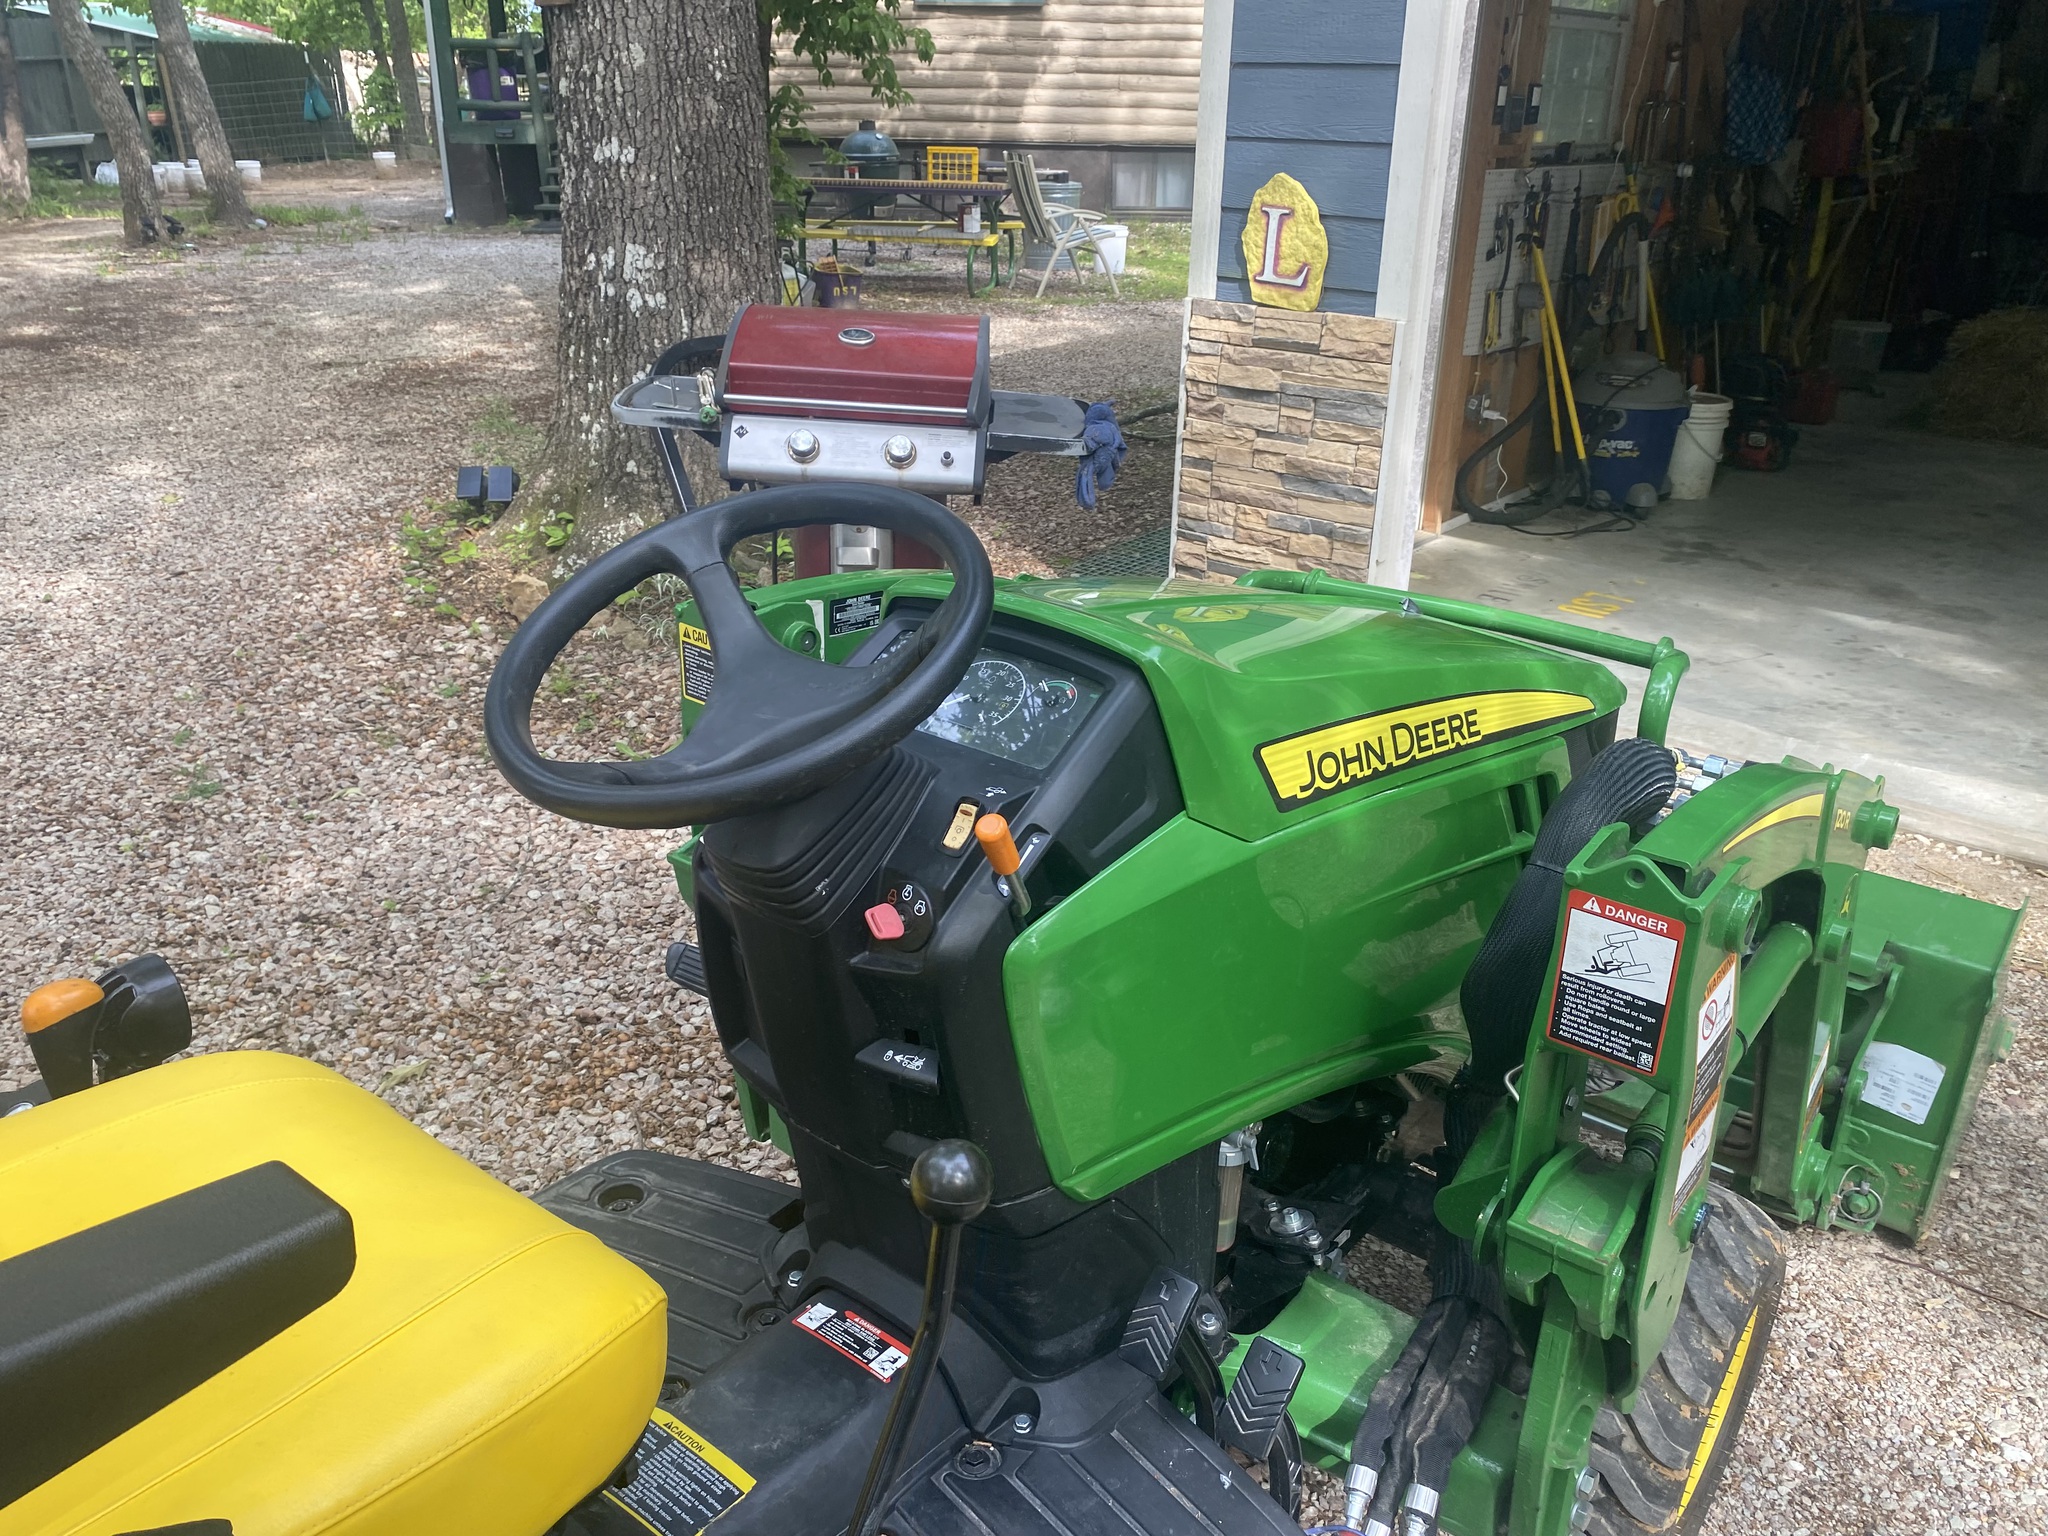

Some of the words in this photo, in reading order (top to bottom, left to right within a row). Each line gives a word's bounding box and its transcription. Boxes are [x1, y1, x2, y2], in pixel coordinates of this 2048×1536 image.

[1255, 206, 1310, 288] L
[1299, 735, 1387, 793] JOHN
[1389, 708, 1482, 763] DEERE
[1604, 904, 1669, 934] DANGER
[1560, 979, 1579, 989] result
[1579, 985, 1595, 995] from
[1595, 991, 1626, 1006] rollovers.
[1562, 973, 1586, 985] Serious
[1586, 982, 1605, 993] injury
[1614, 991, 1633, 1001] death
[1633, 998, 1646, 1006] can
[1564, 994, 1586, 1006] square
[1587, 1001, 1607, 1012] bales.
[1563, 999, 1576, 1008] Use
[1595, 1010, 1607, 1019] and
[1608, 1015, 1633, 1029] seatbelt
[1571, 1008, 1591, 1020] times.
[1576, 991, 1587, 999] not
[1588, 995, 1609, 1007] handle
[1610, 1003, 1629, 1014] round
[1638, 1012, 1656, 1024] large
[1558, 1029, 1571, 1038] Add
[1571, 1034, 1598, 1049] required
[1599, 1045, 1612, 1053] rear
[1612, 1049, 1636, 1062] ballast.
[1559, 1023, 1604, 1044] recommended
[1604, 1040, 1629, 1054] setting.
[1560, 1017, 1578, 1028] Move
[1578, 1024, 1601, 1036] wheels
[1610, 1035, 1631, 1048] widest
[1561, 1011, 1587, 1025] Operate
[1587, 1021, 1609, 1033] tractor
[1618, 1031, 1630, 1040] low
[1630, 1036, 1653, 1050] speed.
[859, 1319, 882, 1335] DANGER
[670, 1426, 706, 1452] CAUTION
